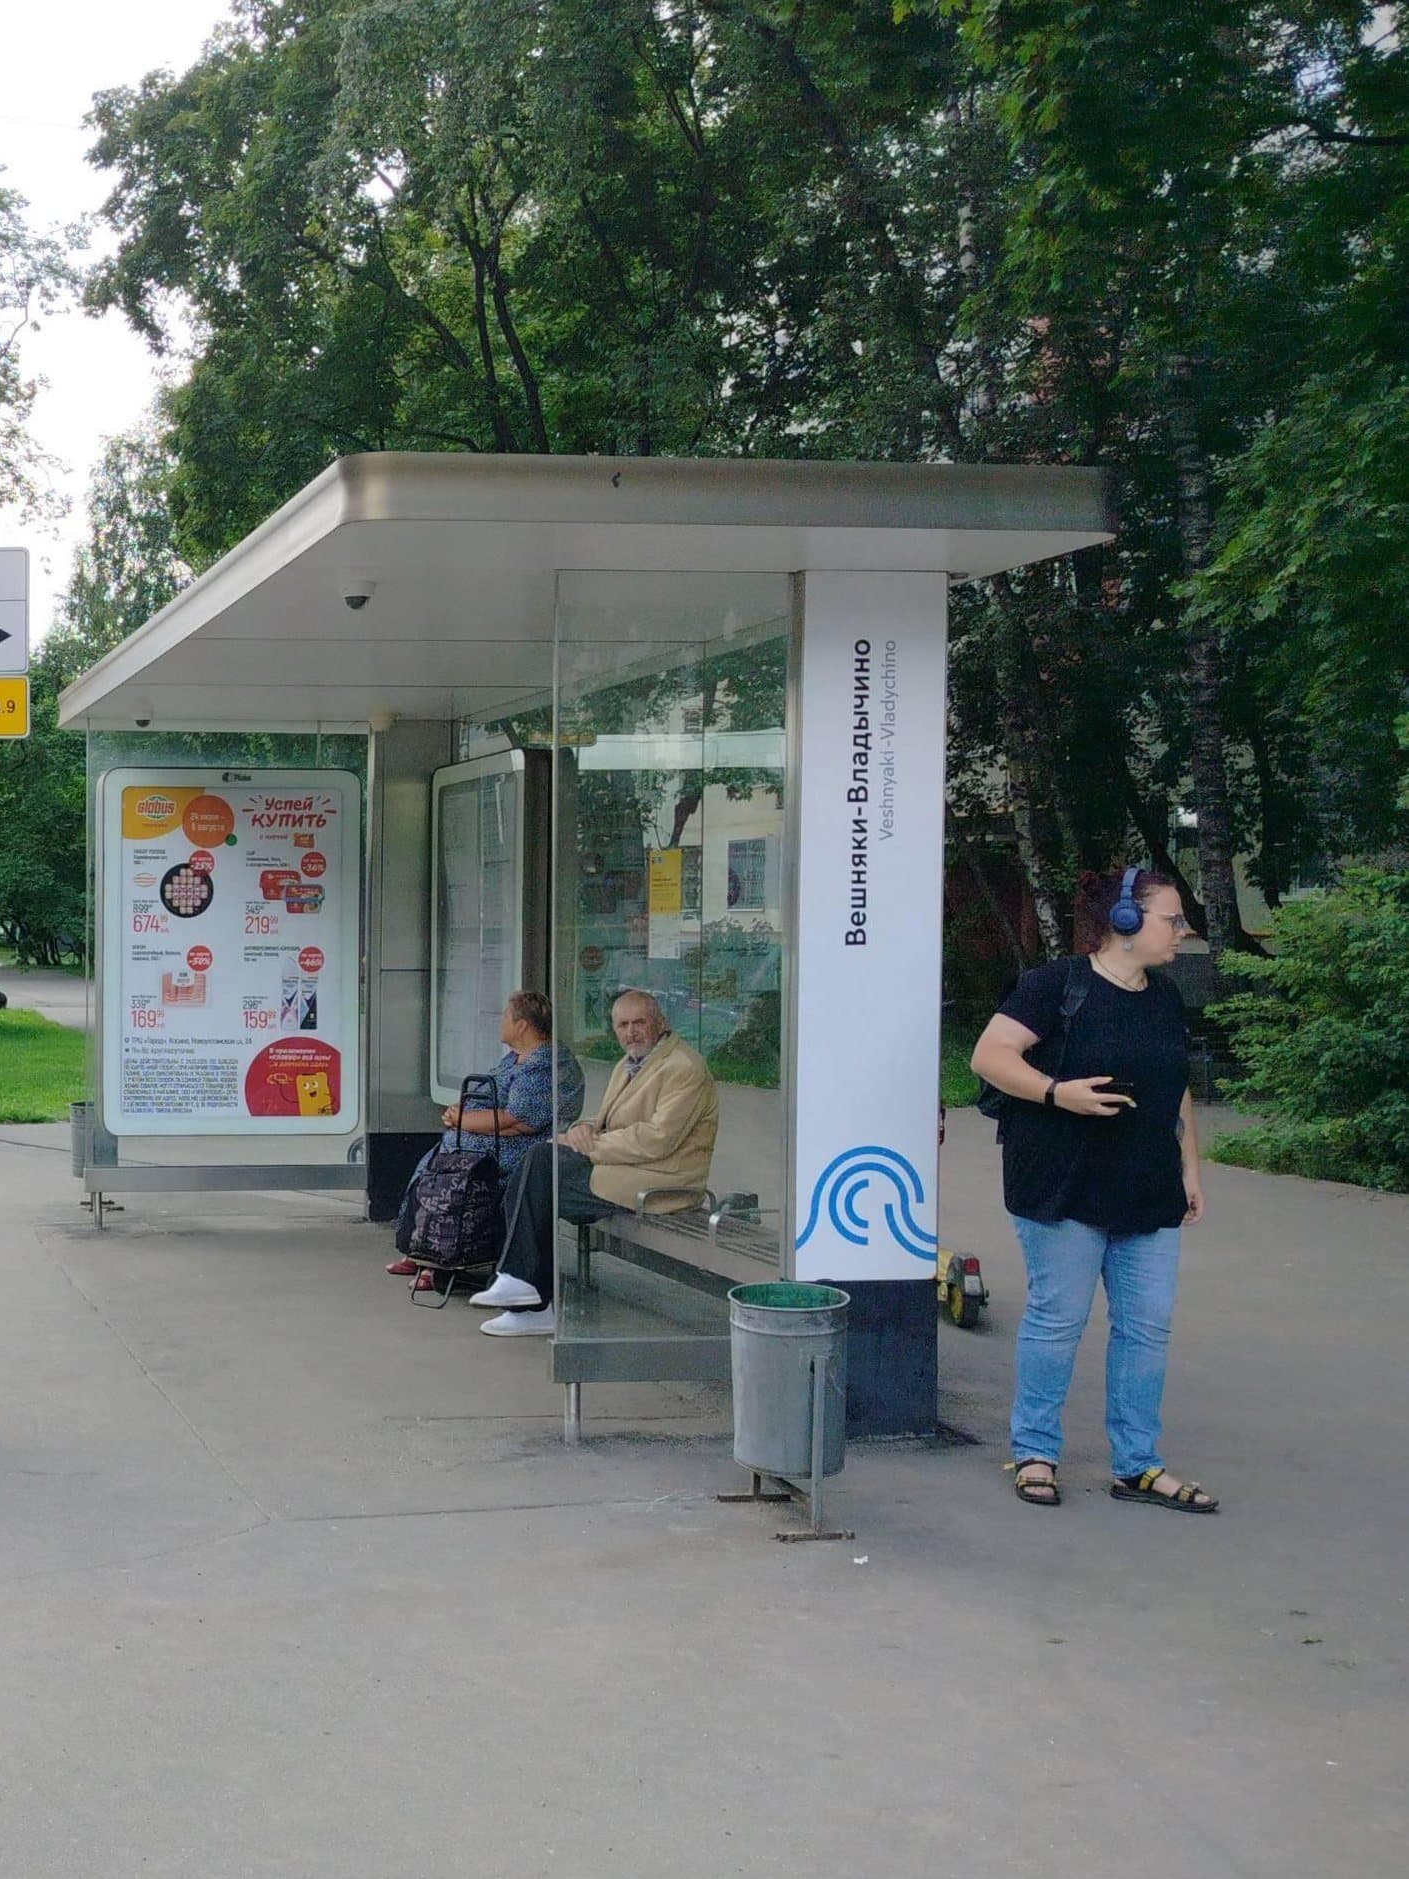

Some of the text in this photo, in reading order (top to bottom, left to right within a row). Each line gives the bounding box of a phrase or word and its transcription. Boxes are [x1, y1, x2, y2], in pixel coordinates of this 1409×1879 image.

[879, 640, 900, 841] Veshnyaki-Vladychino
[845, 638, 871, 947] Вешняки-Владычино
[264, 796, 314, 811] Успей
[251, 813, 327, 828] КУПИТЬ
[133, 915, 160, 933] 674
[245, 915, 270, 934] 219
[131, 1010, 156, 1028] 169
[243, 1011, 268, 1029] 159
